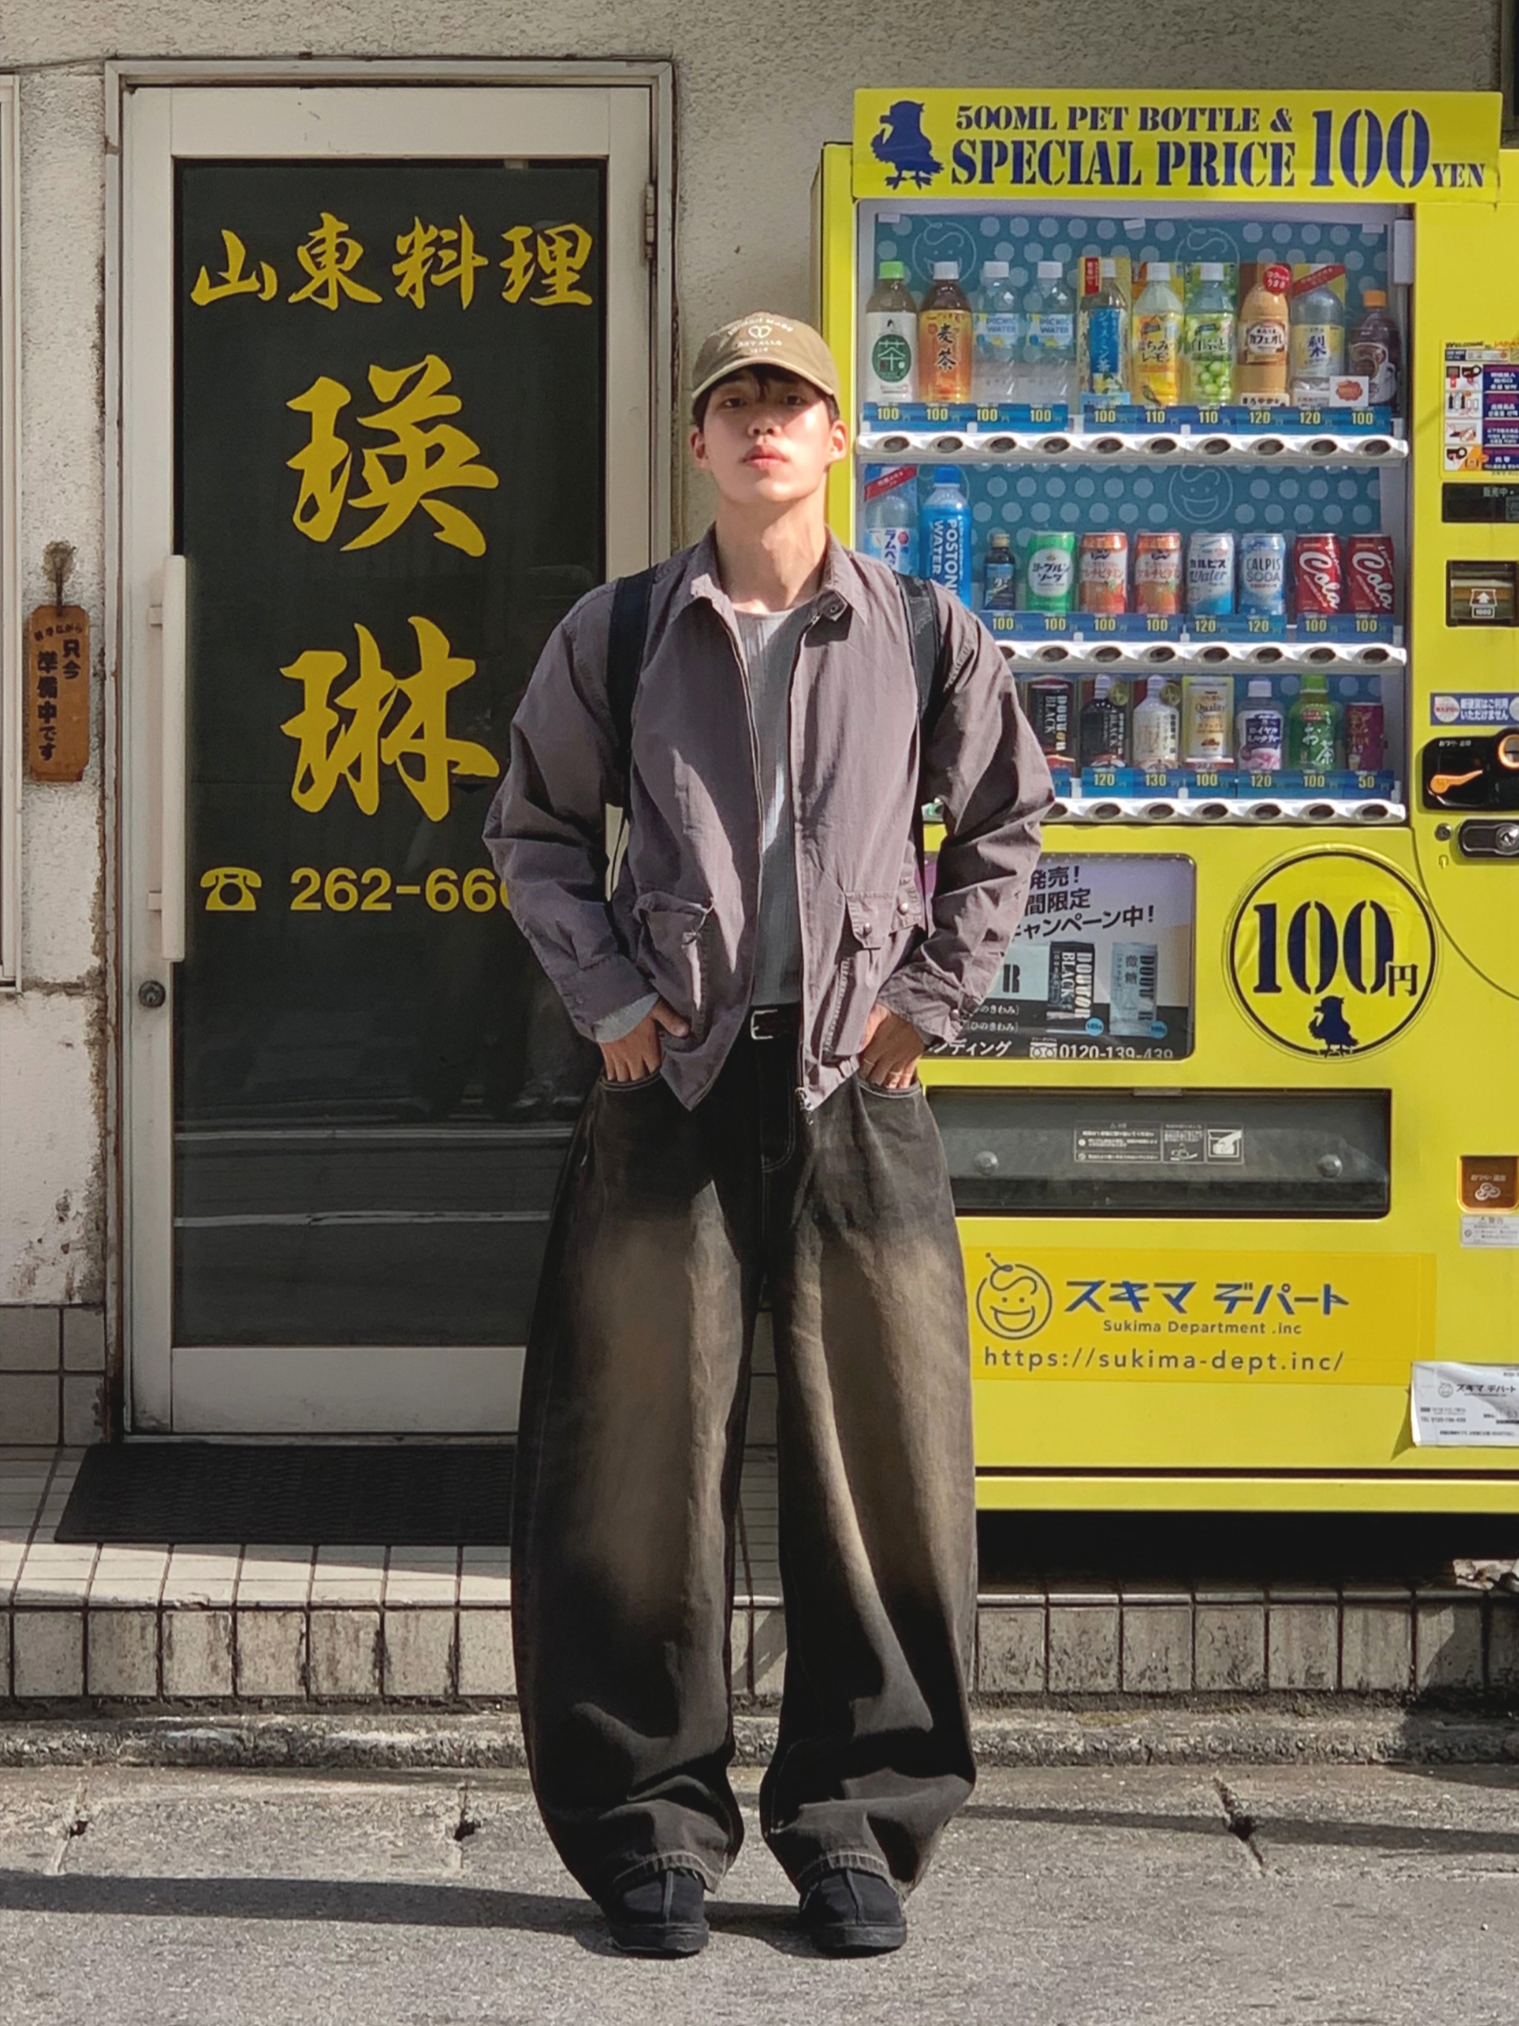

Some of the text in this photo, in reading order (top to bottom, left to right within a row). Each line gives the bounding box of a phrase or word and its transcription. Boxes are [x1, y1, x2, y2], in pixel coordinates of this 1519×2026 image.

[955, 106, 1293, 133] 500ML PET BOTTLE &
[950, 108, 1486, 189] SPECIAL PRICE 100 YEN
[190, 212, 593, 311] 山東料理
[937, 322, 957, 372] 麦茶
[877, 339, 906, 372] 茶
[877, 407, 900, 421] 100
[926, 408, 949, 421] 100
[976, 409, 998, 422] 100
[1030, 409, 1052, 422] 100
[1094, 410, 1116, 423] 100
[1145, 410, 1166, 424] 110
[1198, 410, 1219, 424] 110
[1249, 411, 1271, 425] 120
[1300, 411, 1322, 425] 120
[1352, 411, 1374, 425] 100
[932, 520, 944, 575] WATER
[1246, 557, 1281, 571] CALPIS
[1246, 571, 1281, 582] SODA
[1299, 551, 1341, 610] Cola
[1352, 551, 1393, 610] Cola
[992, 617, 1014, 631] 100
[1044, 618, 1066, 631] 100
[1094, 618, 1116, 631] 100
[1147, 618, 1169, 632] 100
[1195, 619, 1216, 633] 120
[1248, 619, 1270, 633] 120
[1305, 619, 1327, 632] 100
[1355, 619, 1377, 632] 100
[62, 638, 82, 680] 只今
[36, 650, 58, 762] 準備中です
[1044, 695, 1057, 735] BLACK
[1093, 773, 1115, 787] 120
[1145, 773, 1167, 787] 130
[1196, 773, 1218, 787] 100
[1250, 774, 1272, 788] 120
[1303, 775, 1325, 788] 100
[1358, 775, 1375, 789] 50
[290, 867, 510, 913] 262-66
[1060, 951, 1076, 998] BLACK
[1074, 951, 1093, 1019] DOUTOR
[1063, 1279, 1350, 1316] スキマ デパート
[1102, 1318, 1303, 1335] Sukima Department .inc
[984, 1346, 1345, 1375] https://sukima-dept.inc/
